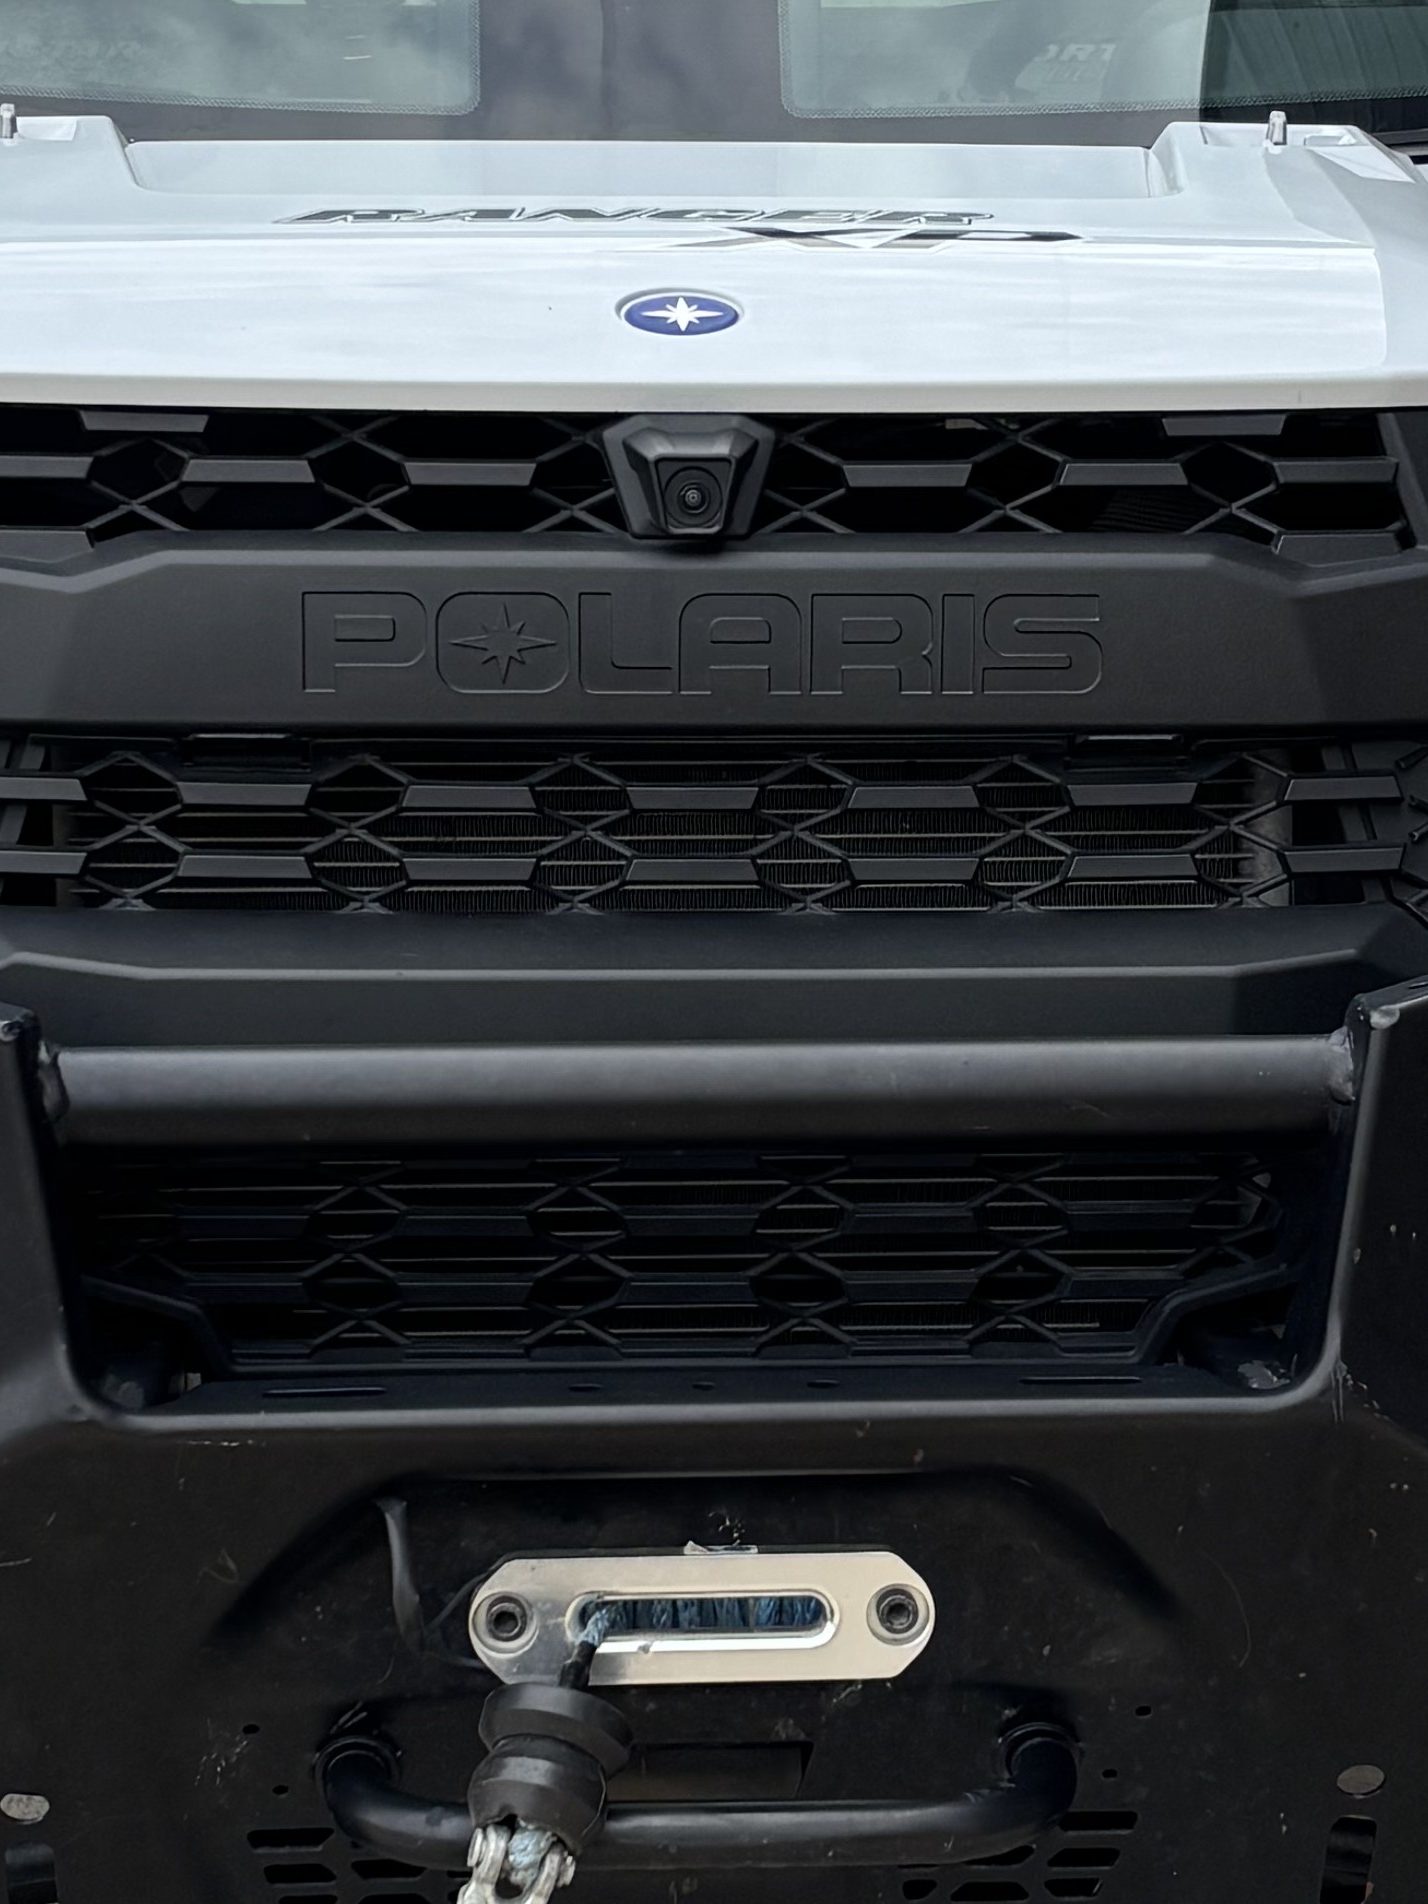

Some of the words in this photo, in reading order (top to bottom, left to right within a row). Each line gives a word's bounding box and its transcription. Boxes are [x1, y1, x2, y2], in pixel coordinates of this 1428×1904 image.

[274, 206, 996, 225] RANGER
[670, 225, 1084, 251] XP
[301, 590, 1105, 695] POLARIS
